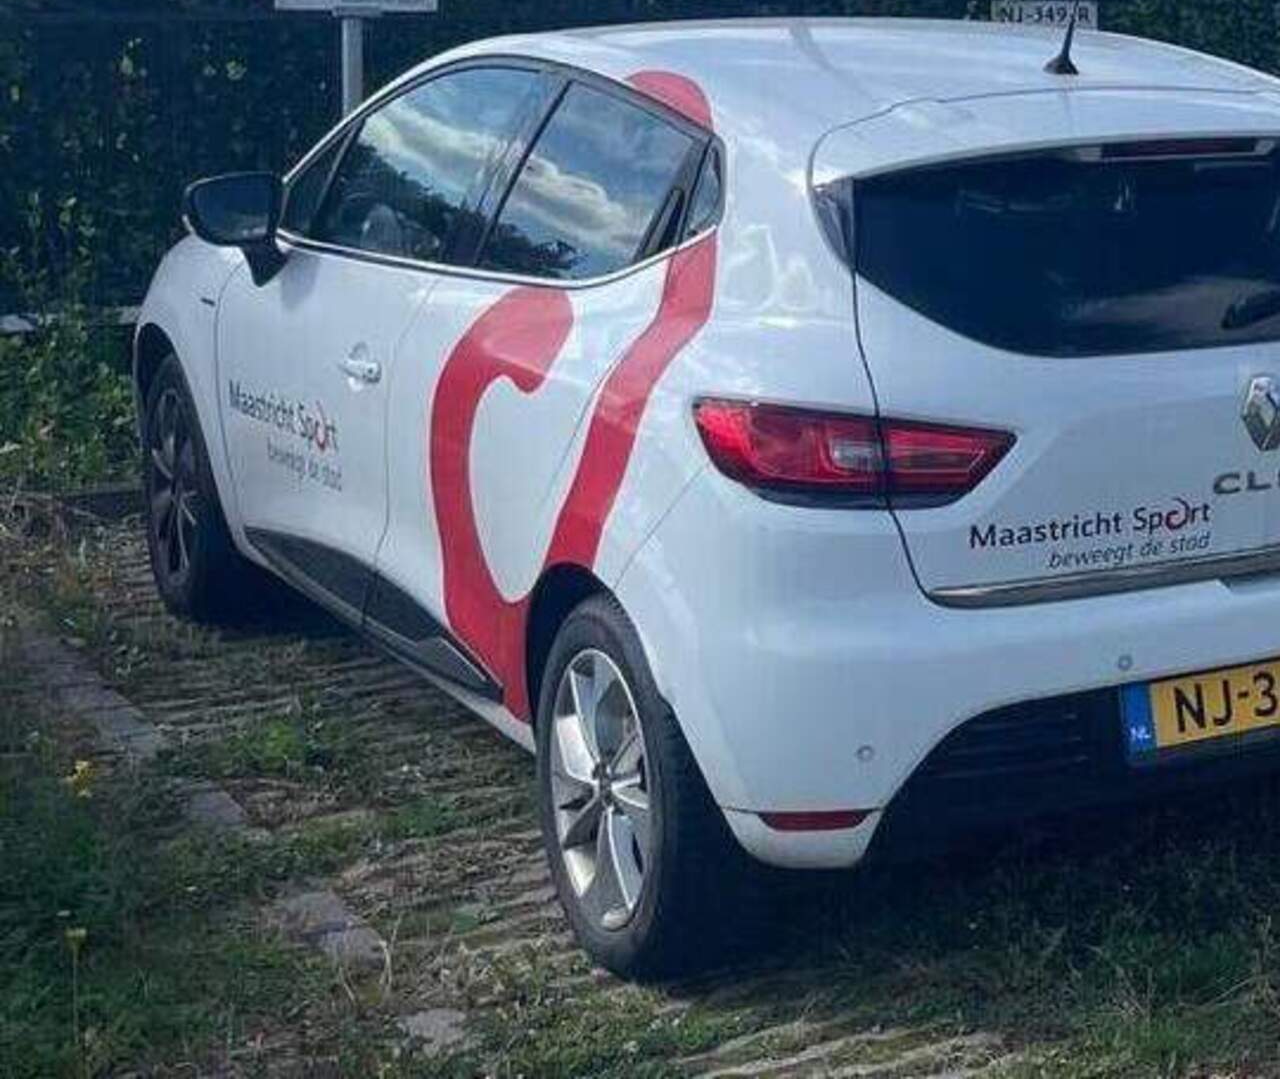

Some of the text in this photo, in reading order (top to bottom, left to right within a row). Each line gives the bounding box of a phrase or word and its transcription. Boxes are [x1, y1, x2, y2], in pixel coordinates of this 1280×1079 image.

[228, 379, 339, 453] Maastricht Sport
[969, 497, 1211, 548] Maastricht Sport
[1050, 530, 1211, 570] beweegt de stad
